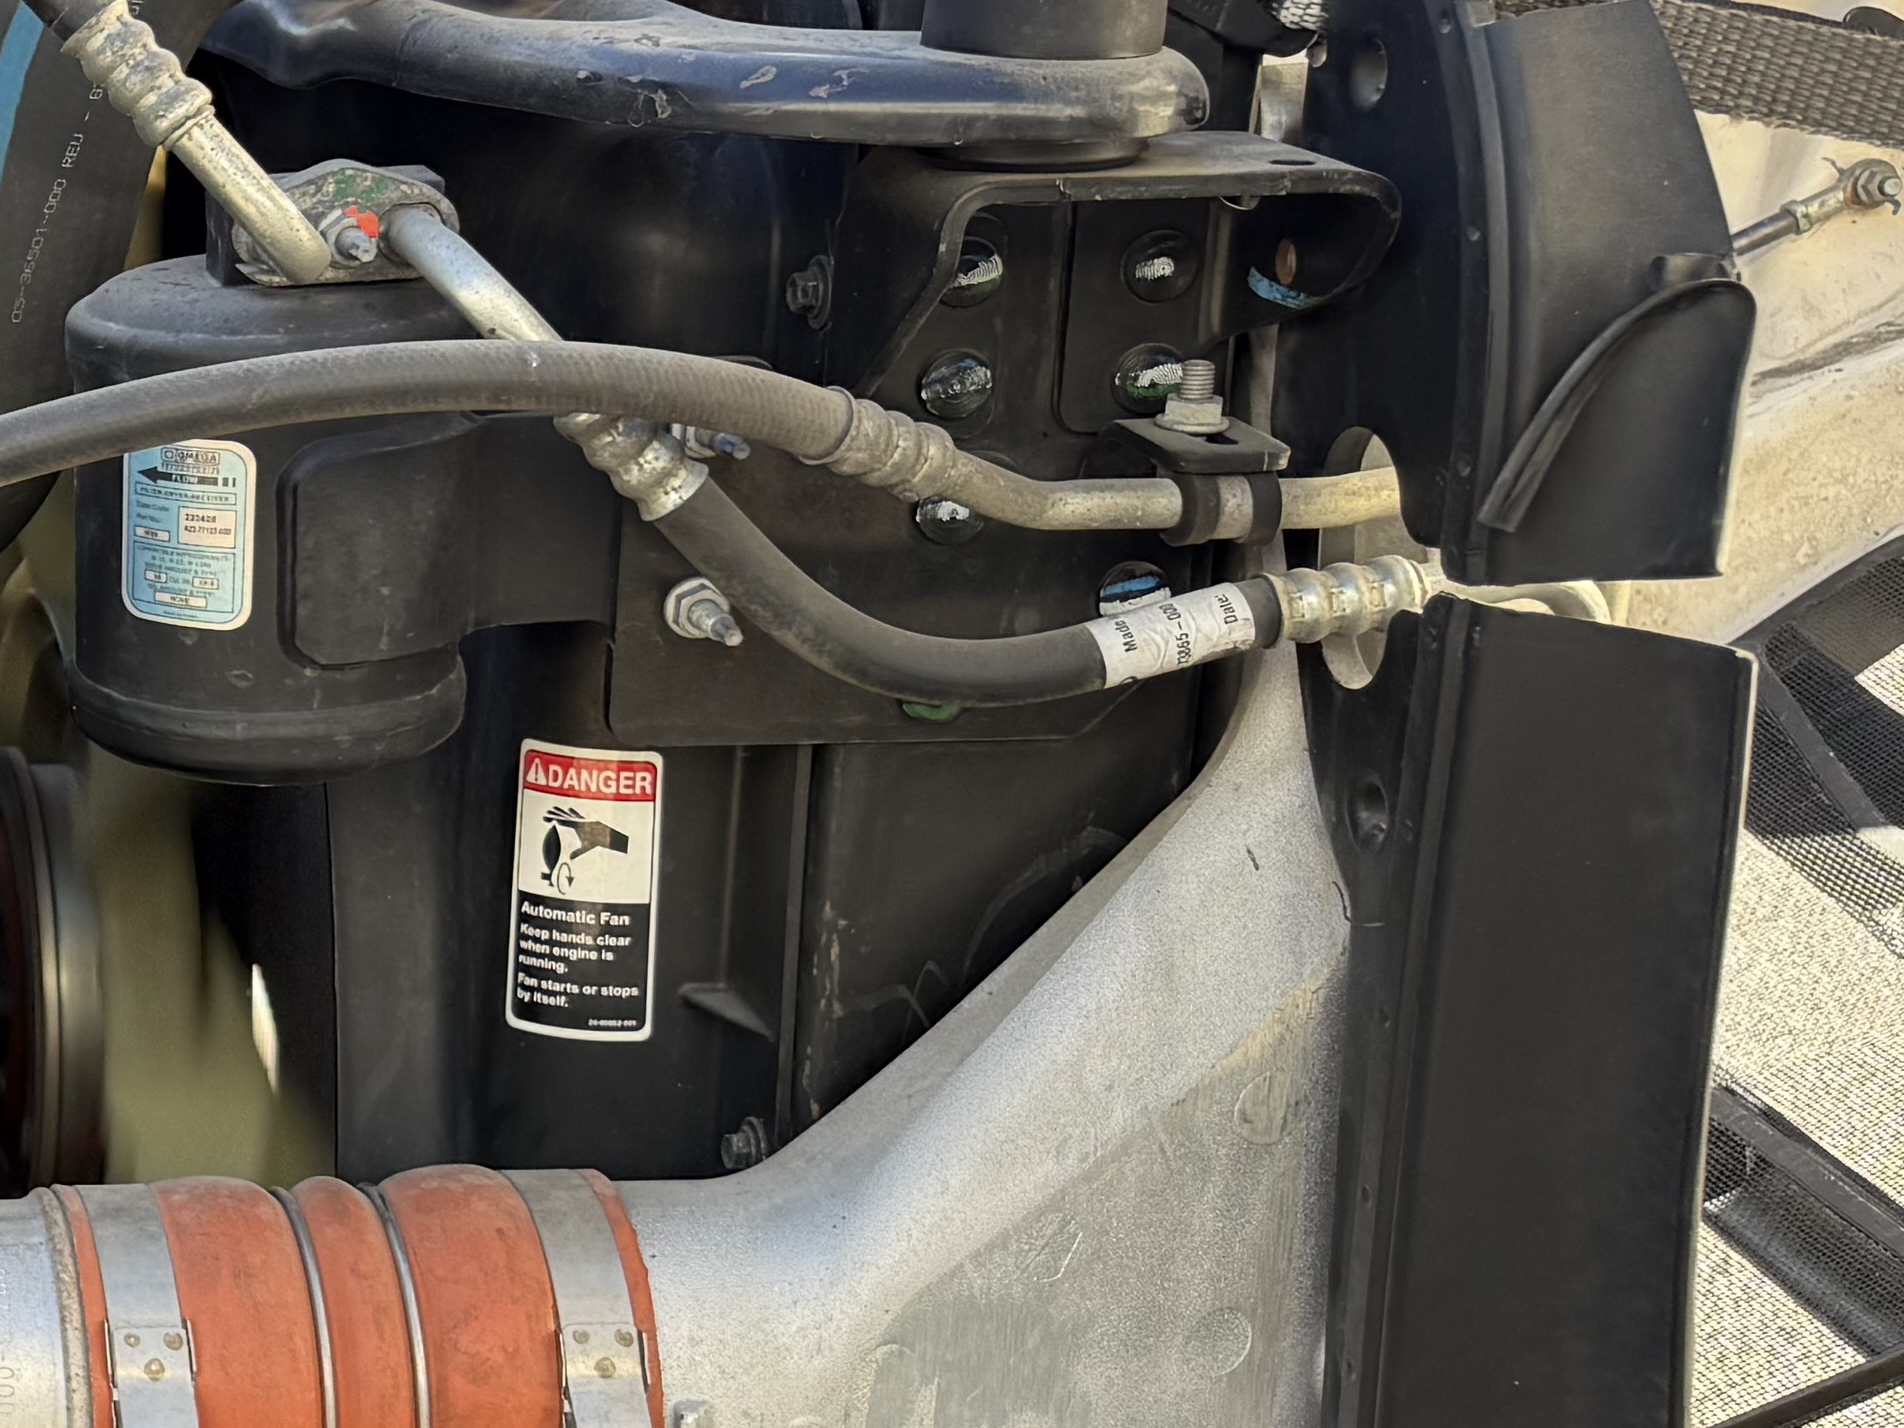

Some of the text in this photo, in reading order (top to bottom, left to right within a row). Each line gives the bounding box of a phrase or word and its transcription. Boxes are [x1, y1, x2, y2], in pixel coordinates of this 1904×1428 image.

[548, 764, 653, 796] DANGER
[521, 901, 630, 925] Automatic Fan
[520, 923, 632, 946] Keep hands clear
[520, 940, 614, 960] when engine is
[519, 955, 568, 974] running.
[518, 972, 638, 998] Fan starts or stops
[517, 987, 568, 1007] by itself.
